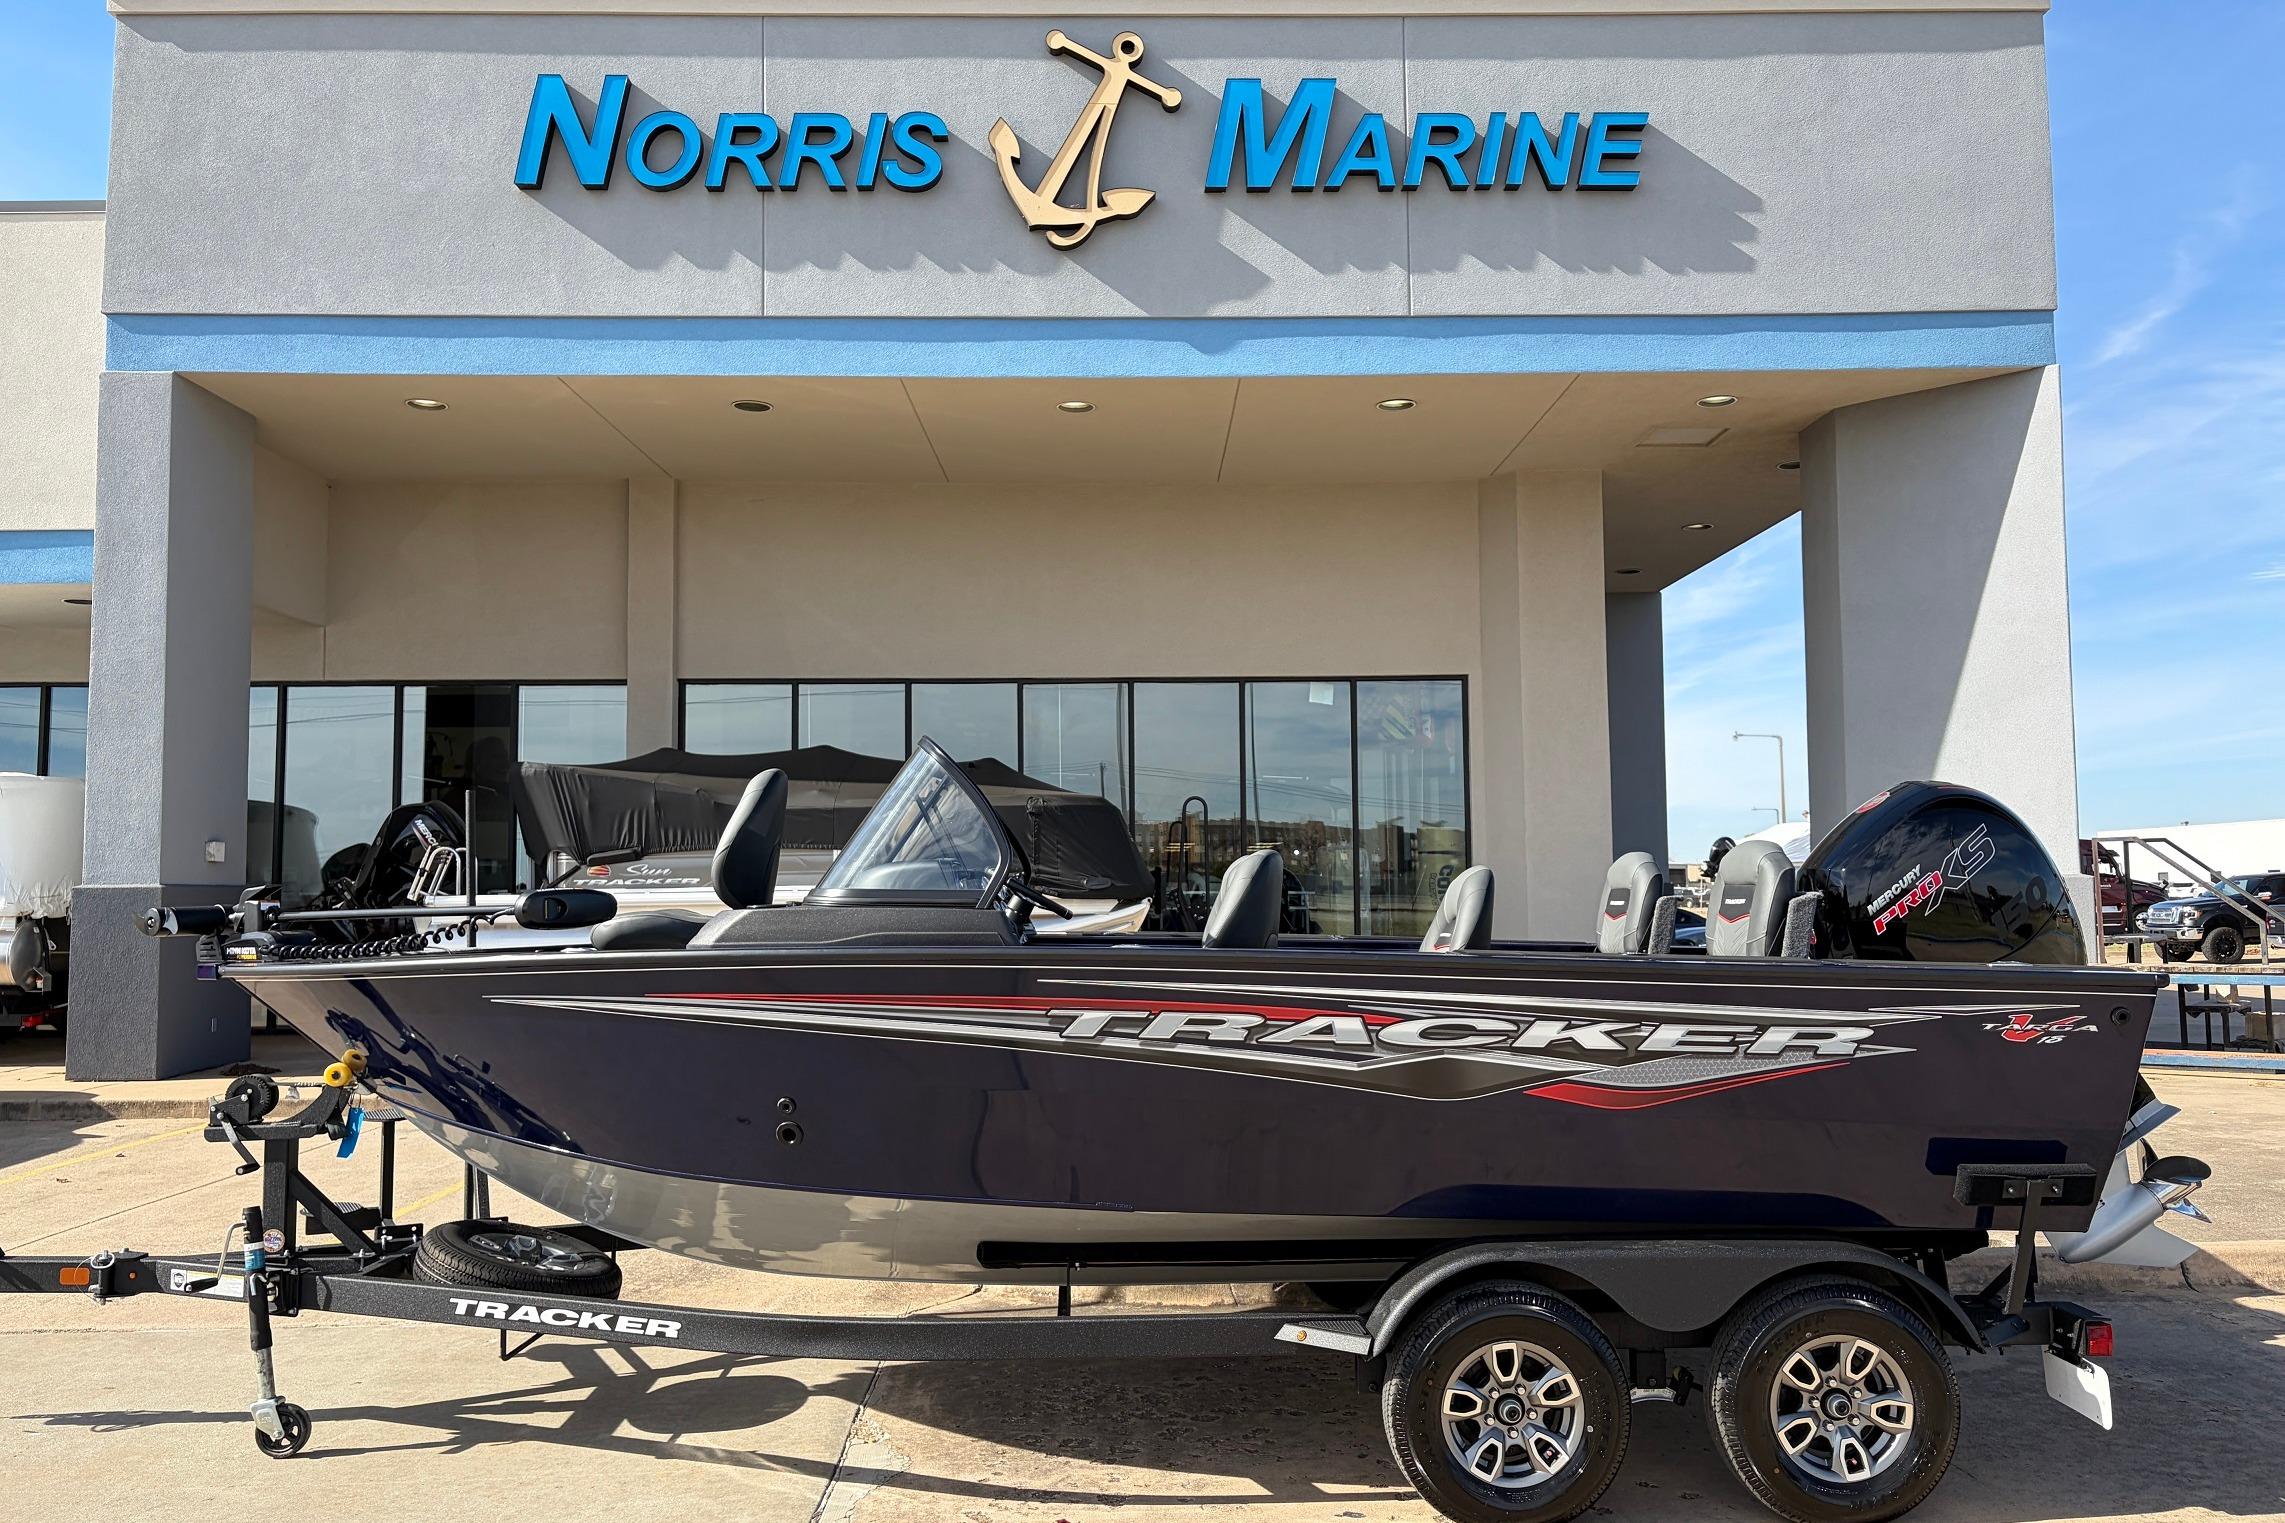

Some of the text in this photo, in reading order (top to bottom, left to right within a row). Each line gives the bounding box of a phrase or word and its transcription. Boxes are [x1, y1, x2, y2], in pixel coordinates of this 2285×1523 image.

[515, 74, 1649, 193] NORRIS MARINE
[414, 818, 441, 848] MERC
[573, 877, 701, 886] TRACKER
[621, 863, 673, 877] Sun
[1866, 864, 1921, 917] MERCURY
[1873, 870, 1943, 936] PRO
[1991, 875, 2047, 940] 150
[1046, 1008, 1875, 1057] TRACKER
[1982, 1023, 2099, 1033] TARGA
[450, 1298, 682, 1338] TRACKER
